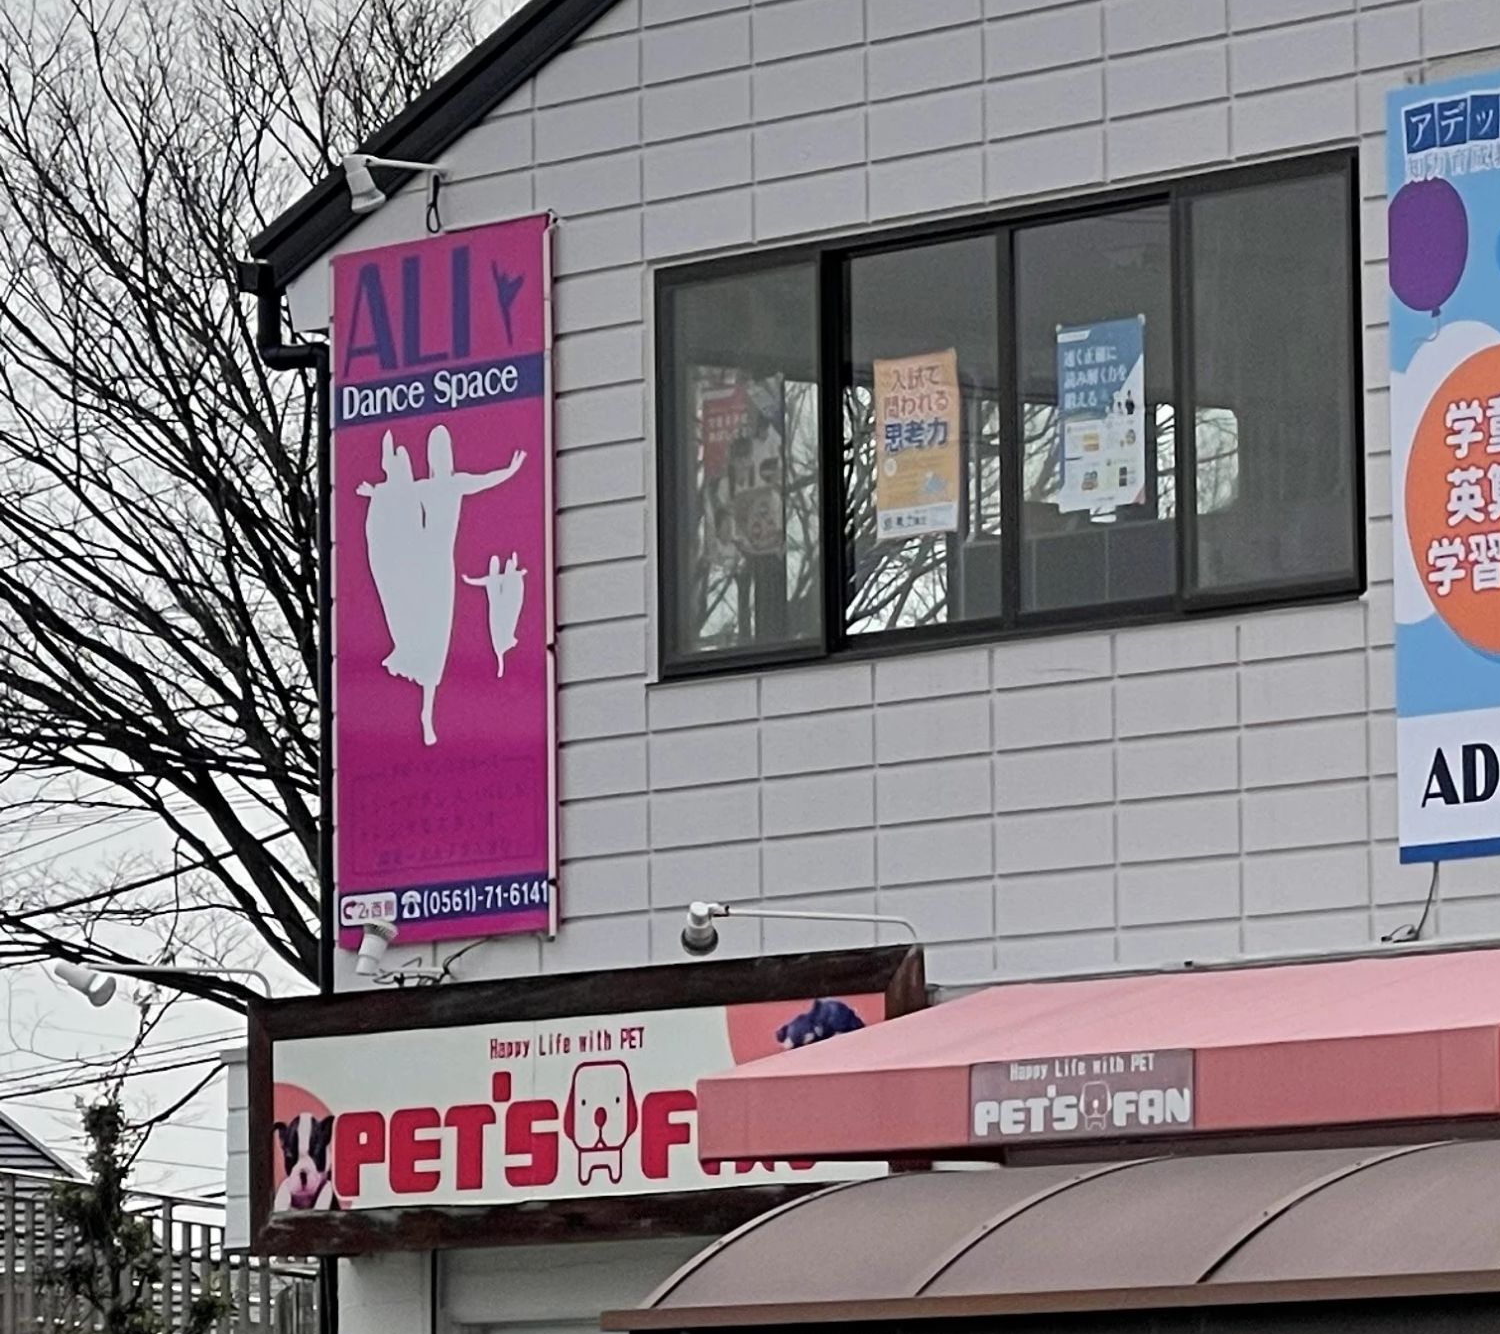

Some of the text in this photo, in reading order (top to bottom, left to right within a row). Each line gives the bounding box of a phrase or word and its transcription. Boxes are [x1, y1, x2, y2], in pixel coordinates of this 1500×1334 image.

[344, 245, 470, 378] ALI
[342, 365, 518, 420] Dance Space
[884, 417, 949, 452] 思考力
[423, 880, 548, 917] (0561)-71-6141
[489, 1026, 645, 1060] Happy Life with PET
[1009, 1053, 1155, 1081] Happy Life with PET
[974, 1084, 1190, 1136] PET'S FAN
[333, 1071, 560, 1198] PET'S
